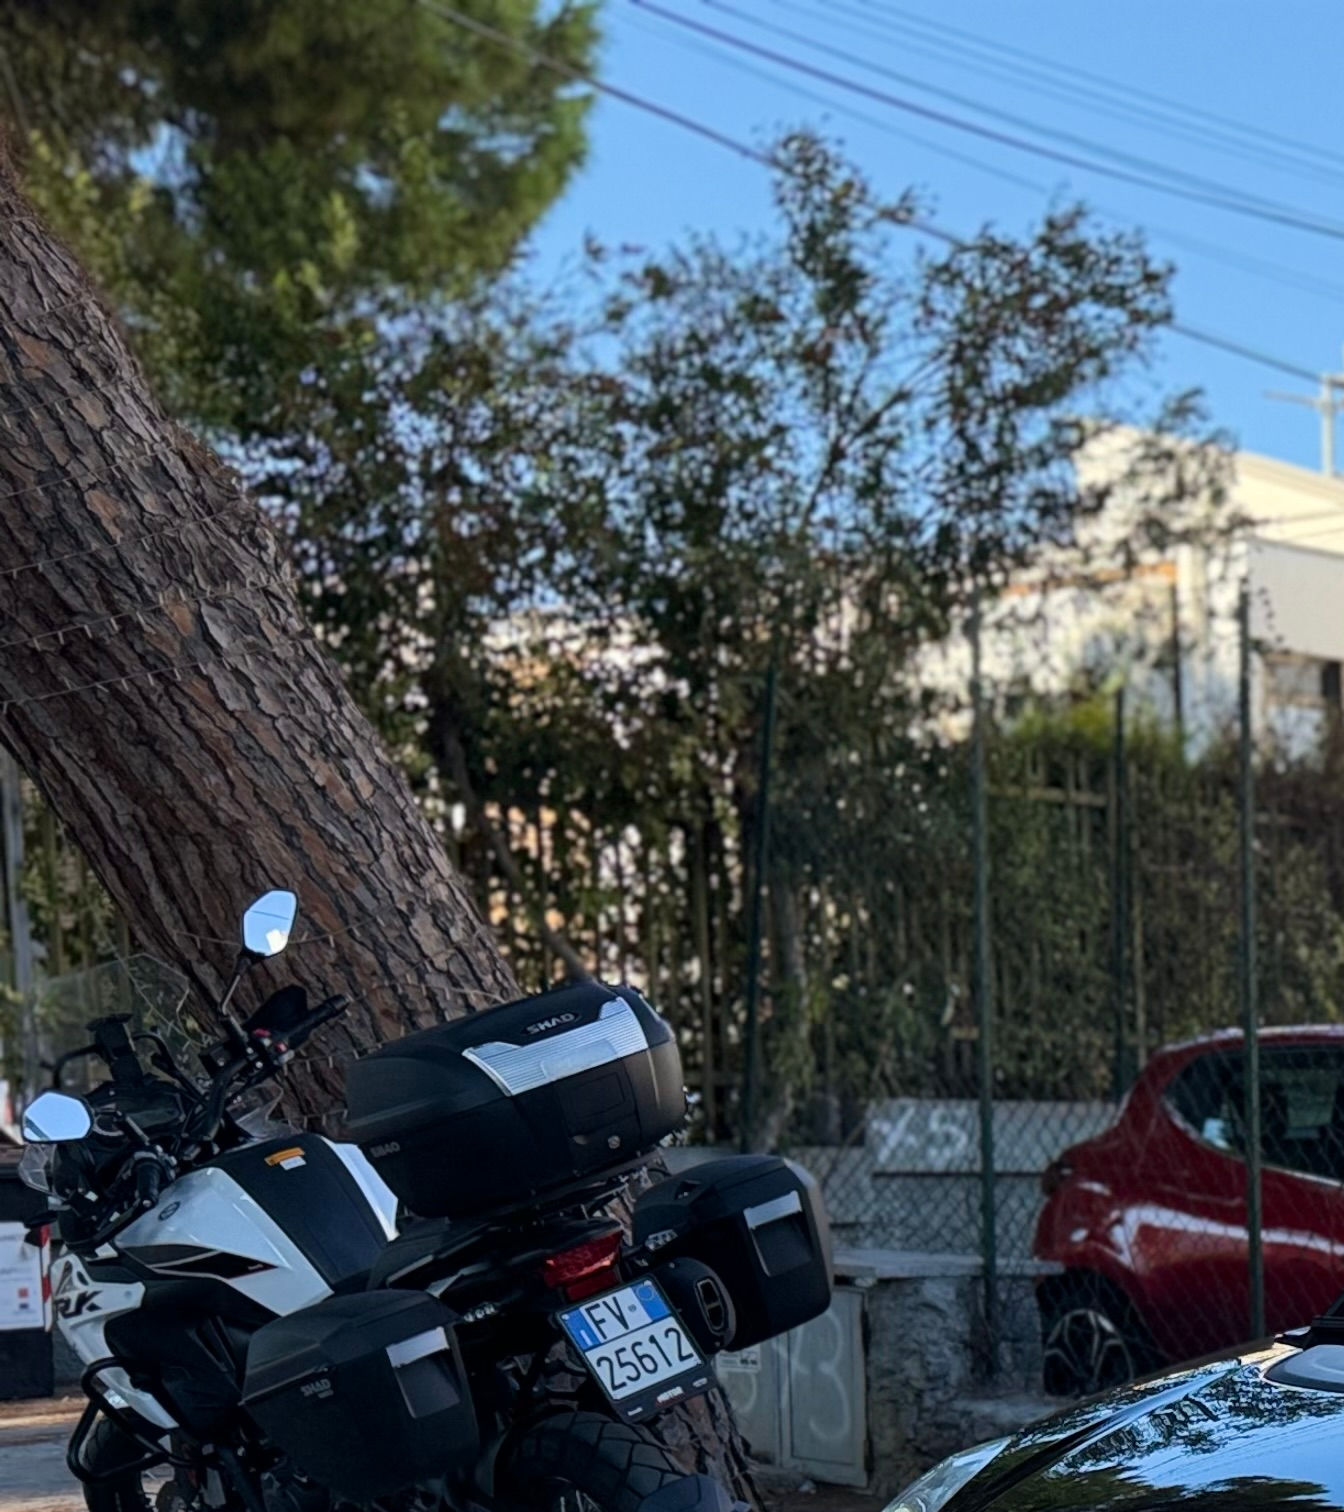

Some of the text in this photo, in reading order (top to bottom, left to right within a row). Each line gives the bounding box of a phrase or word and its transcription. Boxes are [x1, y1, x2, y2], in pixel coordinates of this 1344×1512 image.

[526, 1012, 576, 1035] SHAD
[584, 1296, 630, 1340] FV
[596, 1327, 694, 1391] 25612
